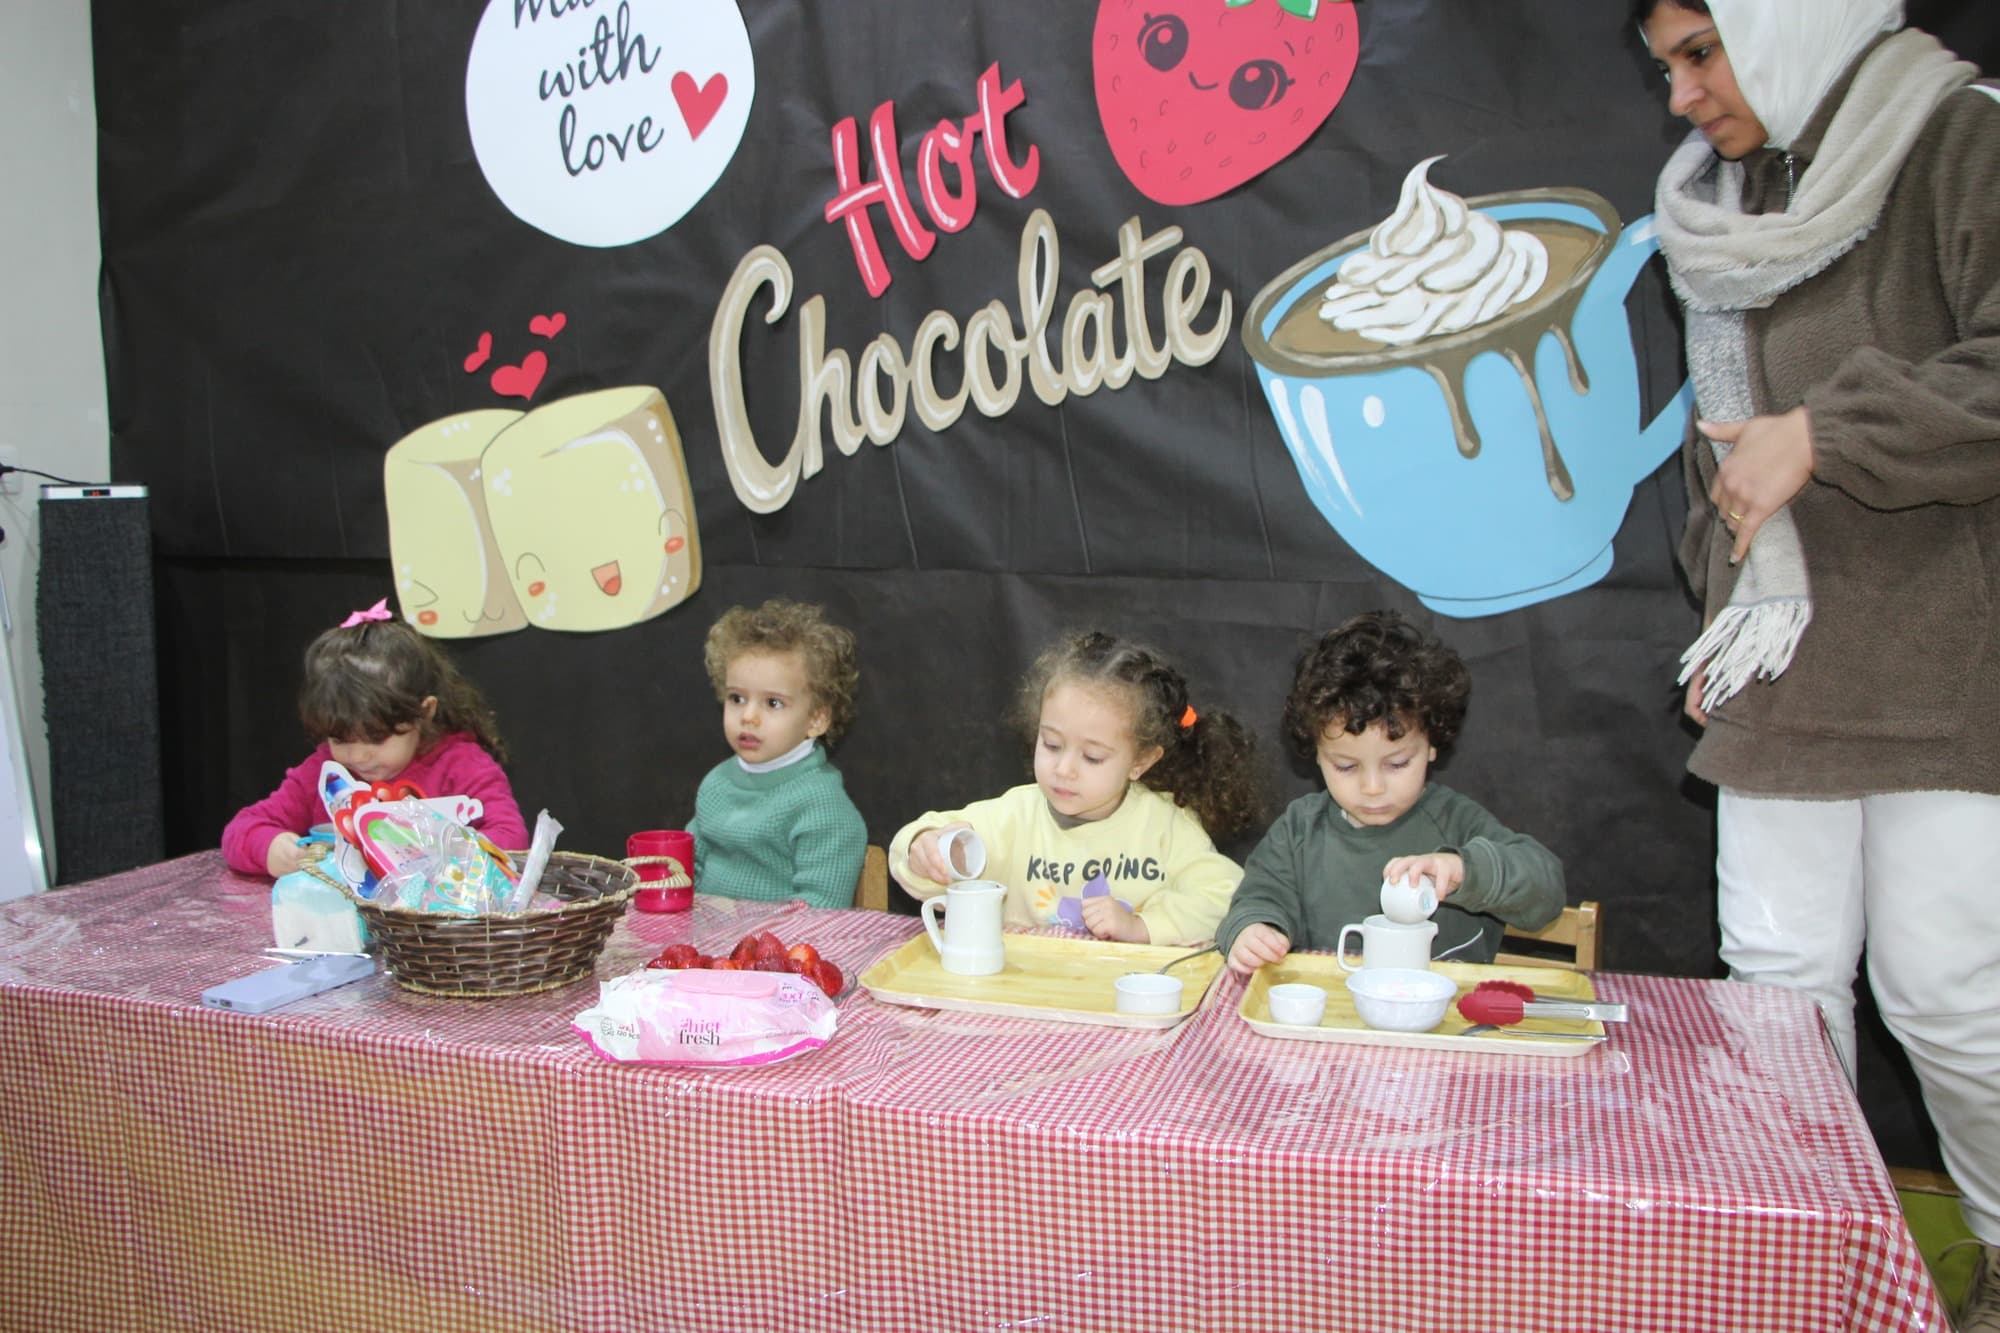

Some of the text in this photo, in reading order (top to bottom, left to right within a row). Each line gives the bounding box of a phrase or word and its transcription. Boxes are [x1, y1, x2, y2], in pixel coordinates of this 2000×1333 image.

[539, 0, 661, 101] with
[559, 103, 664, 176] love
[825, 60, 1040, 298] Hot
[708, 207, 1232, 514] Chocolate
[679, 1029, 720, 1046] fresh
